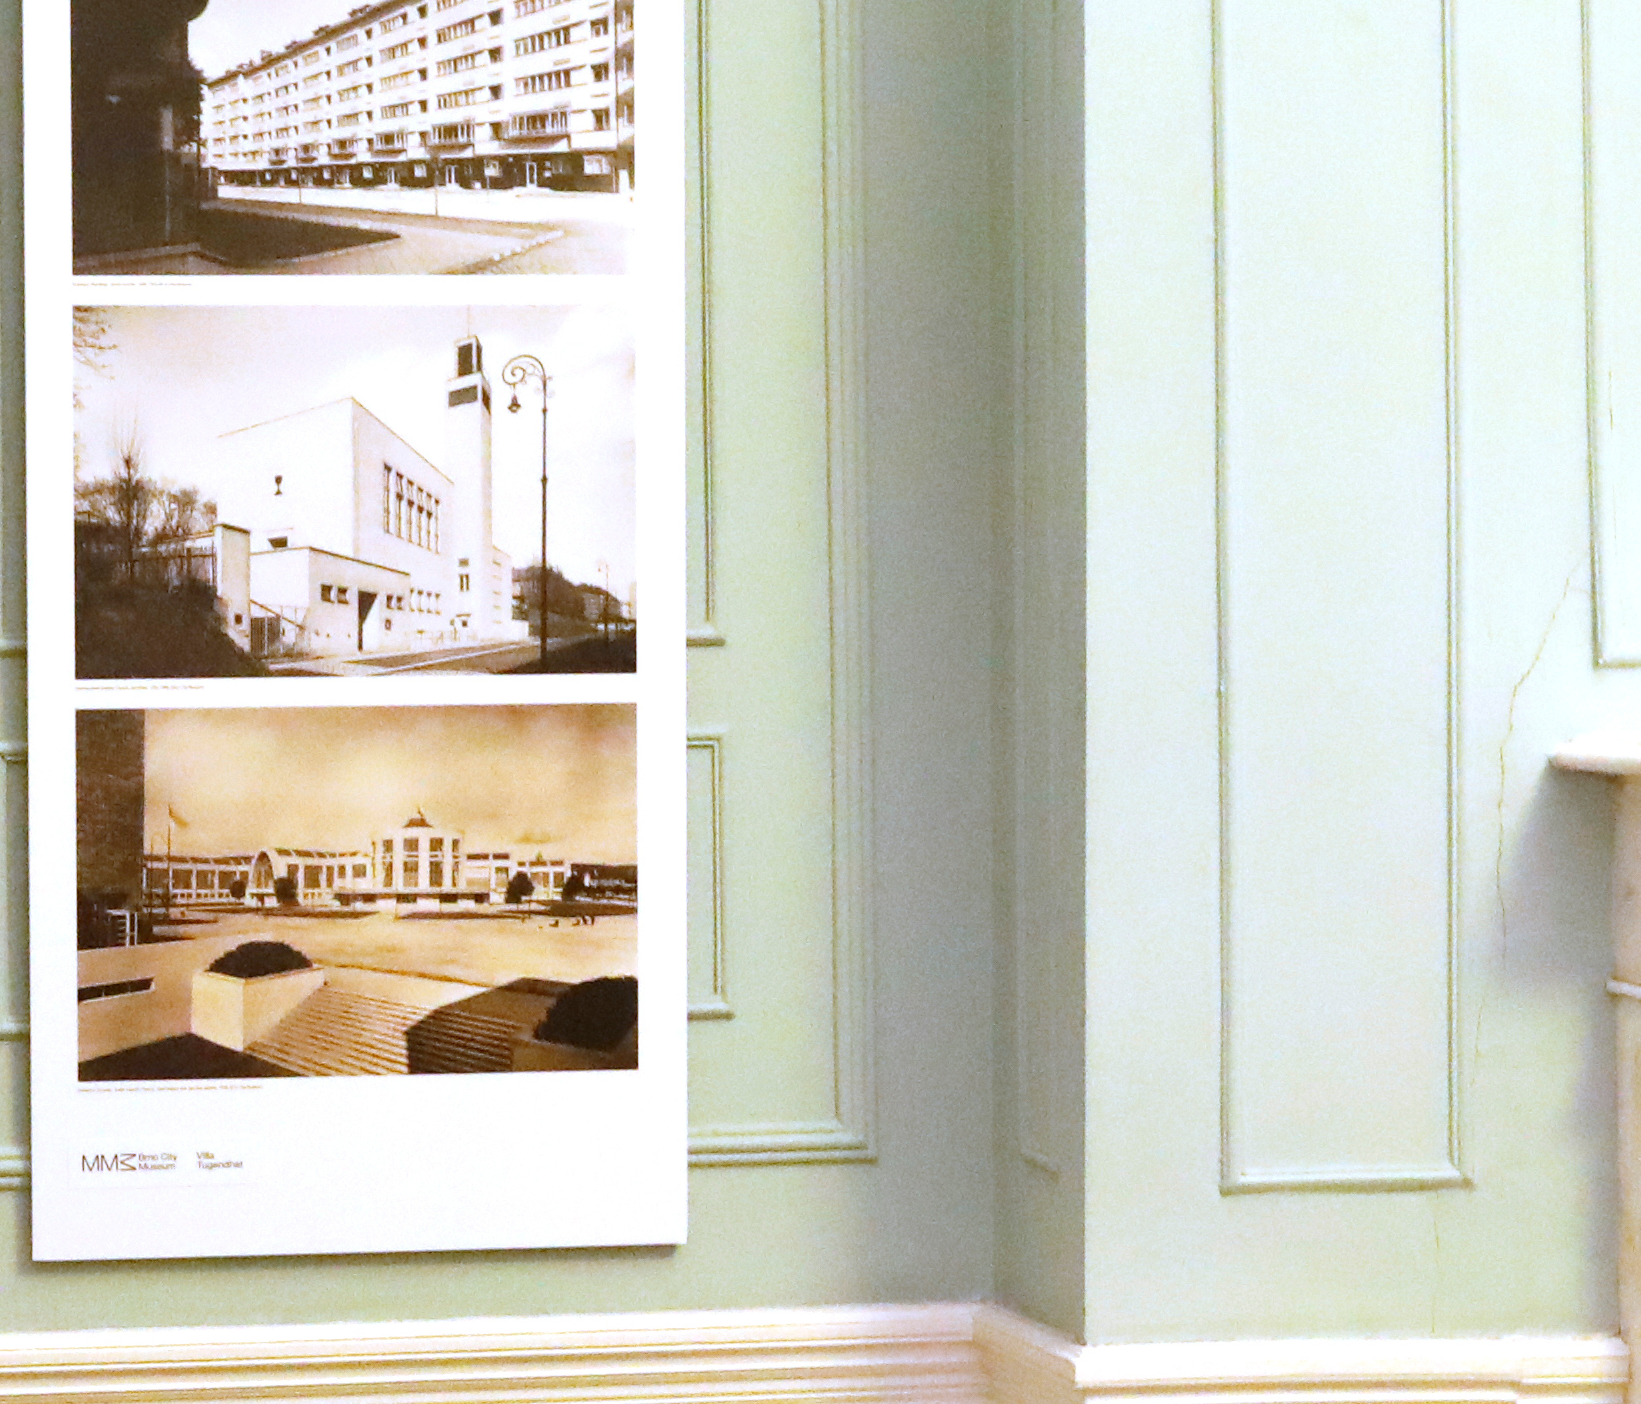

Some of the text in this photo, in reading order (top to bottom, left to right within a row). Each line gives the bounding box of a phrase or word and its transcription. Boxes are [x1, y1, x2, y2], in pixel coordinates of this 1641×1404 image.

[138, 1152, 178, 1162] Brno City
[196, 1151, 215, 1160] Villa
[138, 1162, 176, 1171] Museum
[197, 1161, 244, 1171] Tugendhat
